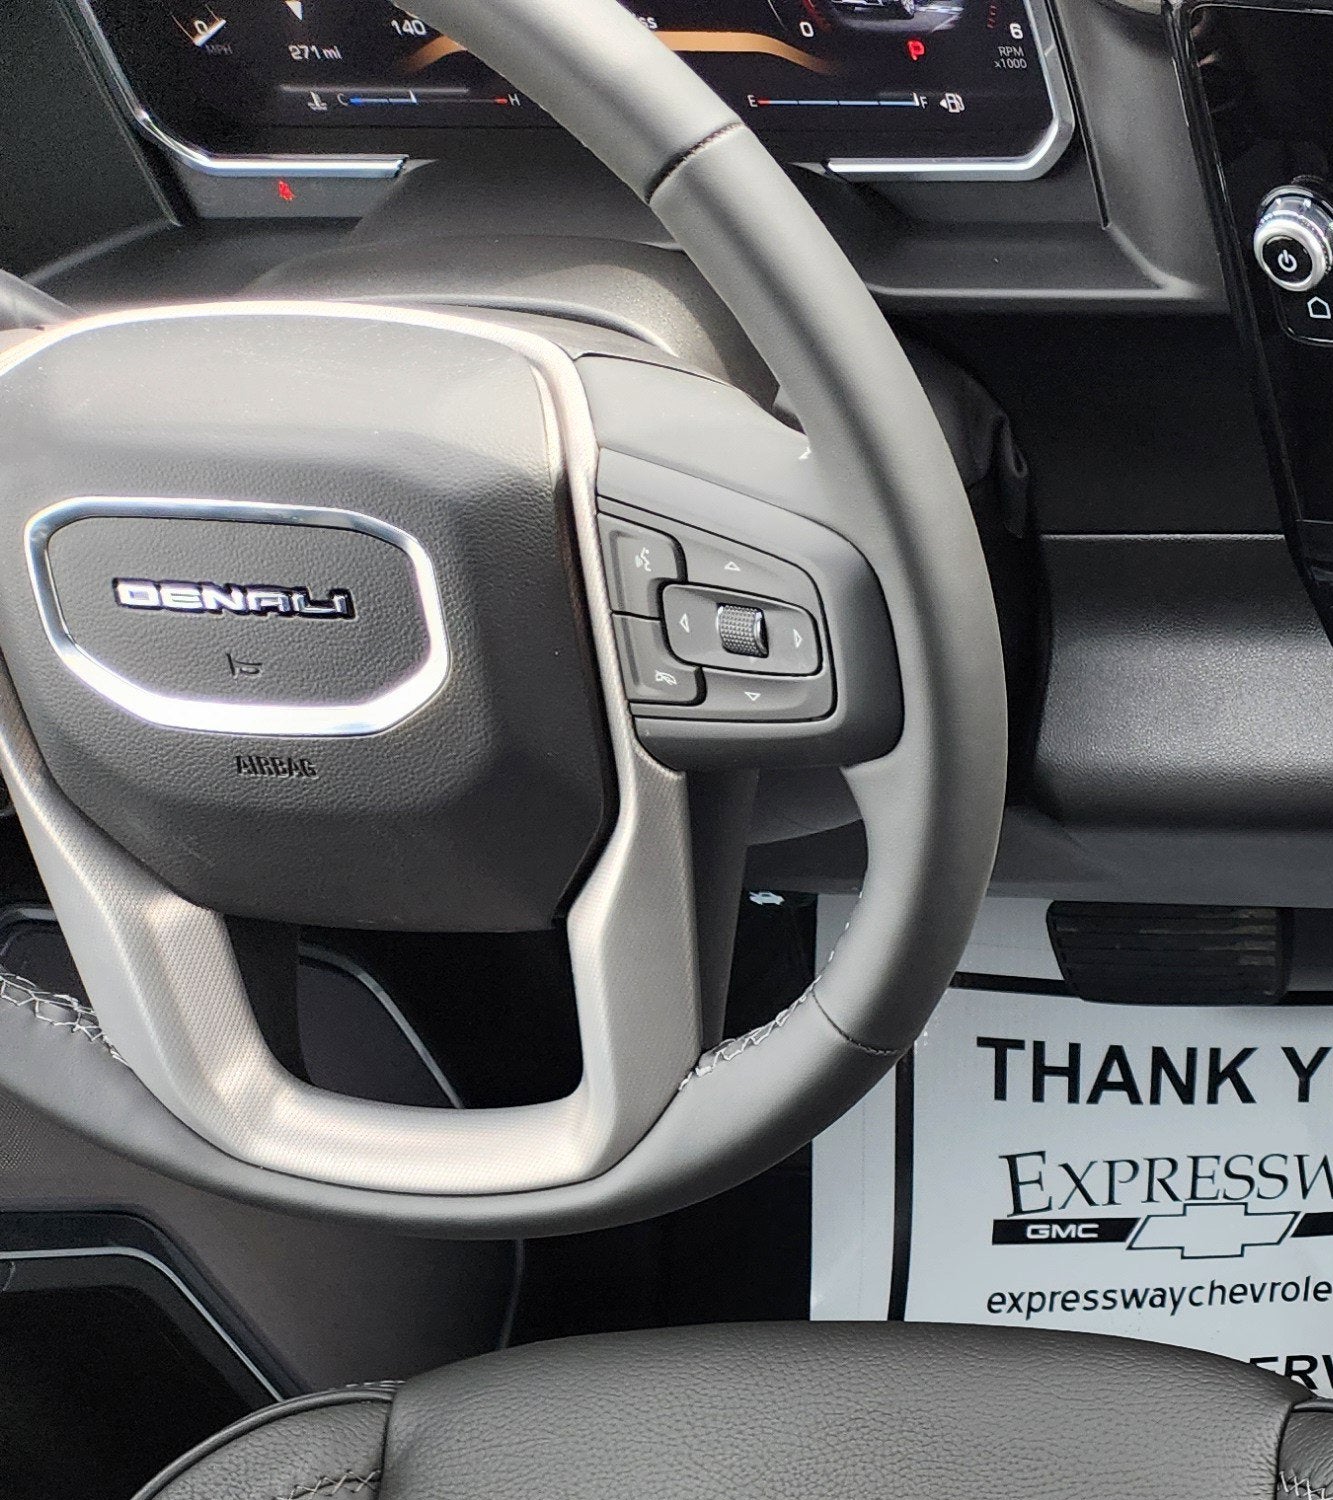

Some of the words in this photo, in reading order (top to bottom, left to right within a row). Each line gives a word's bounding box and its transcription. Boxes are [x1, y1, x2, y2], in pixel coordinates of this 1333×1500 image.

[389, 19, 428, 36] 140
[799, 21, 815, 38] 0
[1009, 22, 1024, 40] 6
[288, 45, 321, 60] 271
[322, 46, 342, 60] mi
[908, 39, 925, 61] P
[999, 46, 1024, 59] RPM
[994, 58, 1028, 70] x1000
[508, 94, 521, 107] H
[747, 94, 758, 108] E
[919, 96, 929, 109] F
[114, 577, 355, 619] DENALI
[234, 754, 319, 780] AIRBAG
[976, 1036, 1259, 1106] THANK
[1025, 1222, 1099, 1239] GMC
